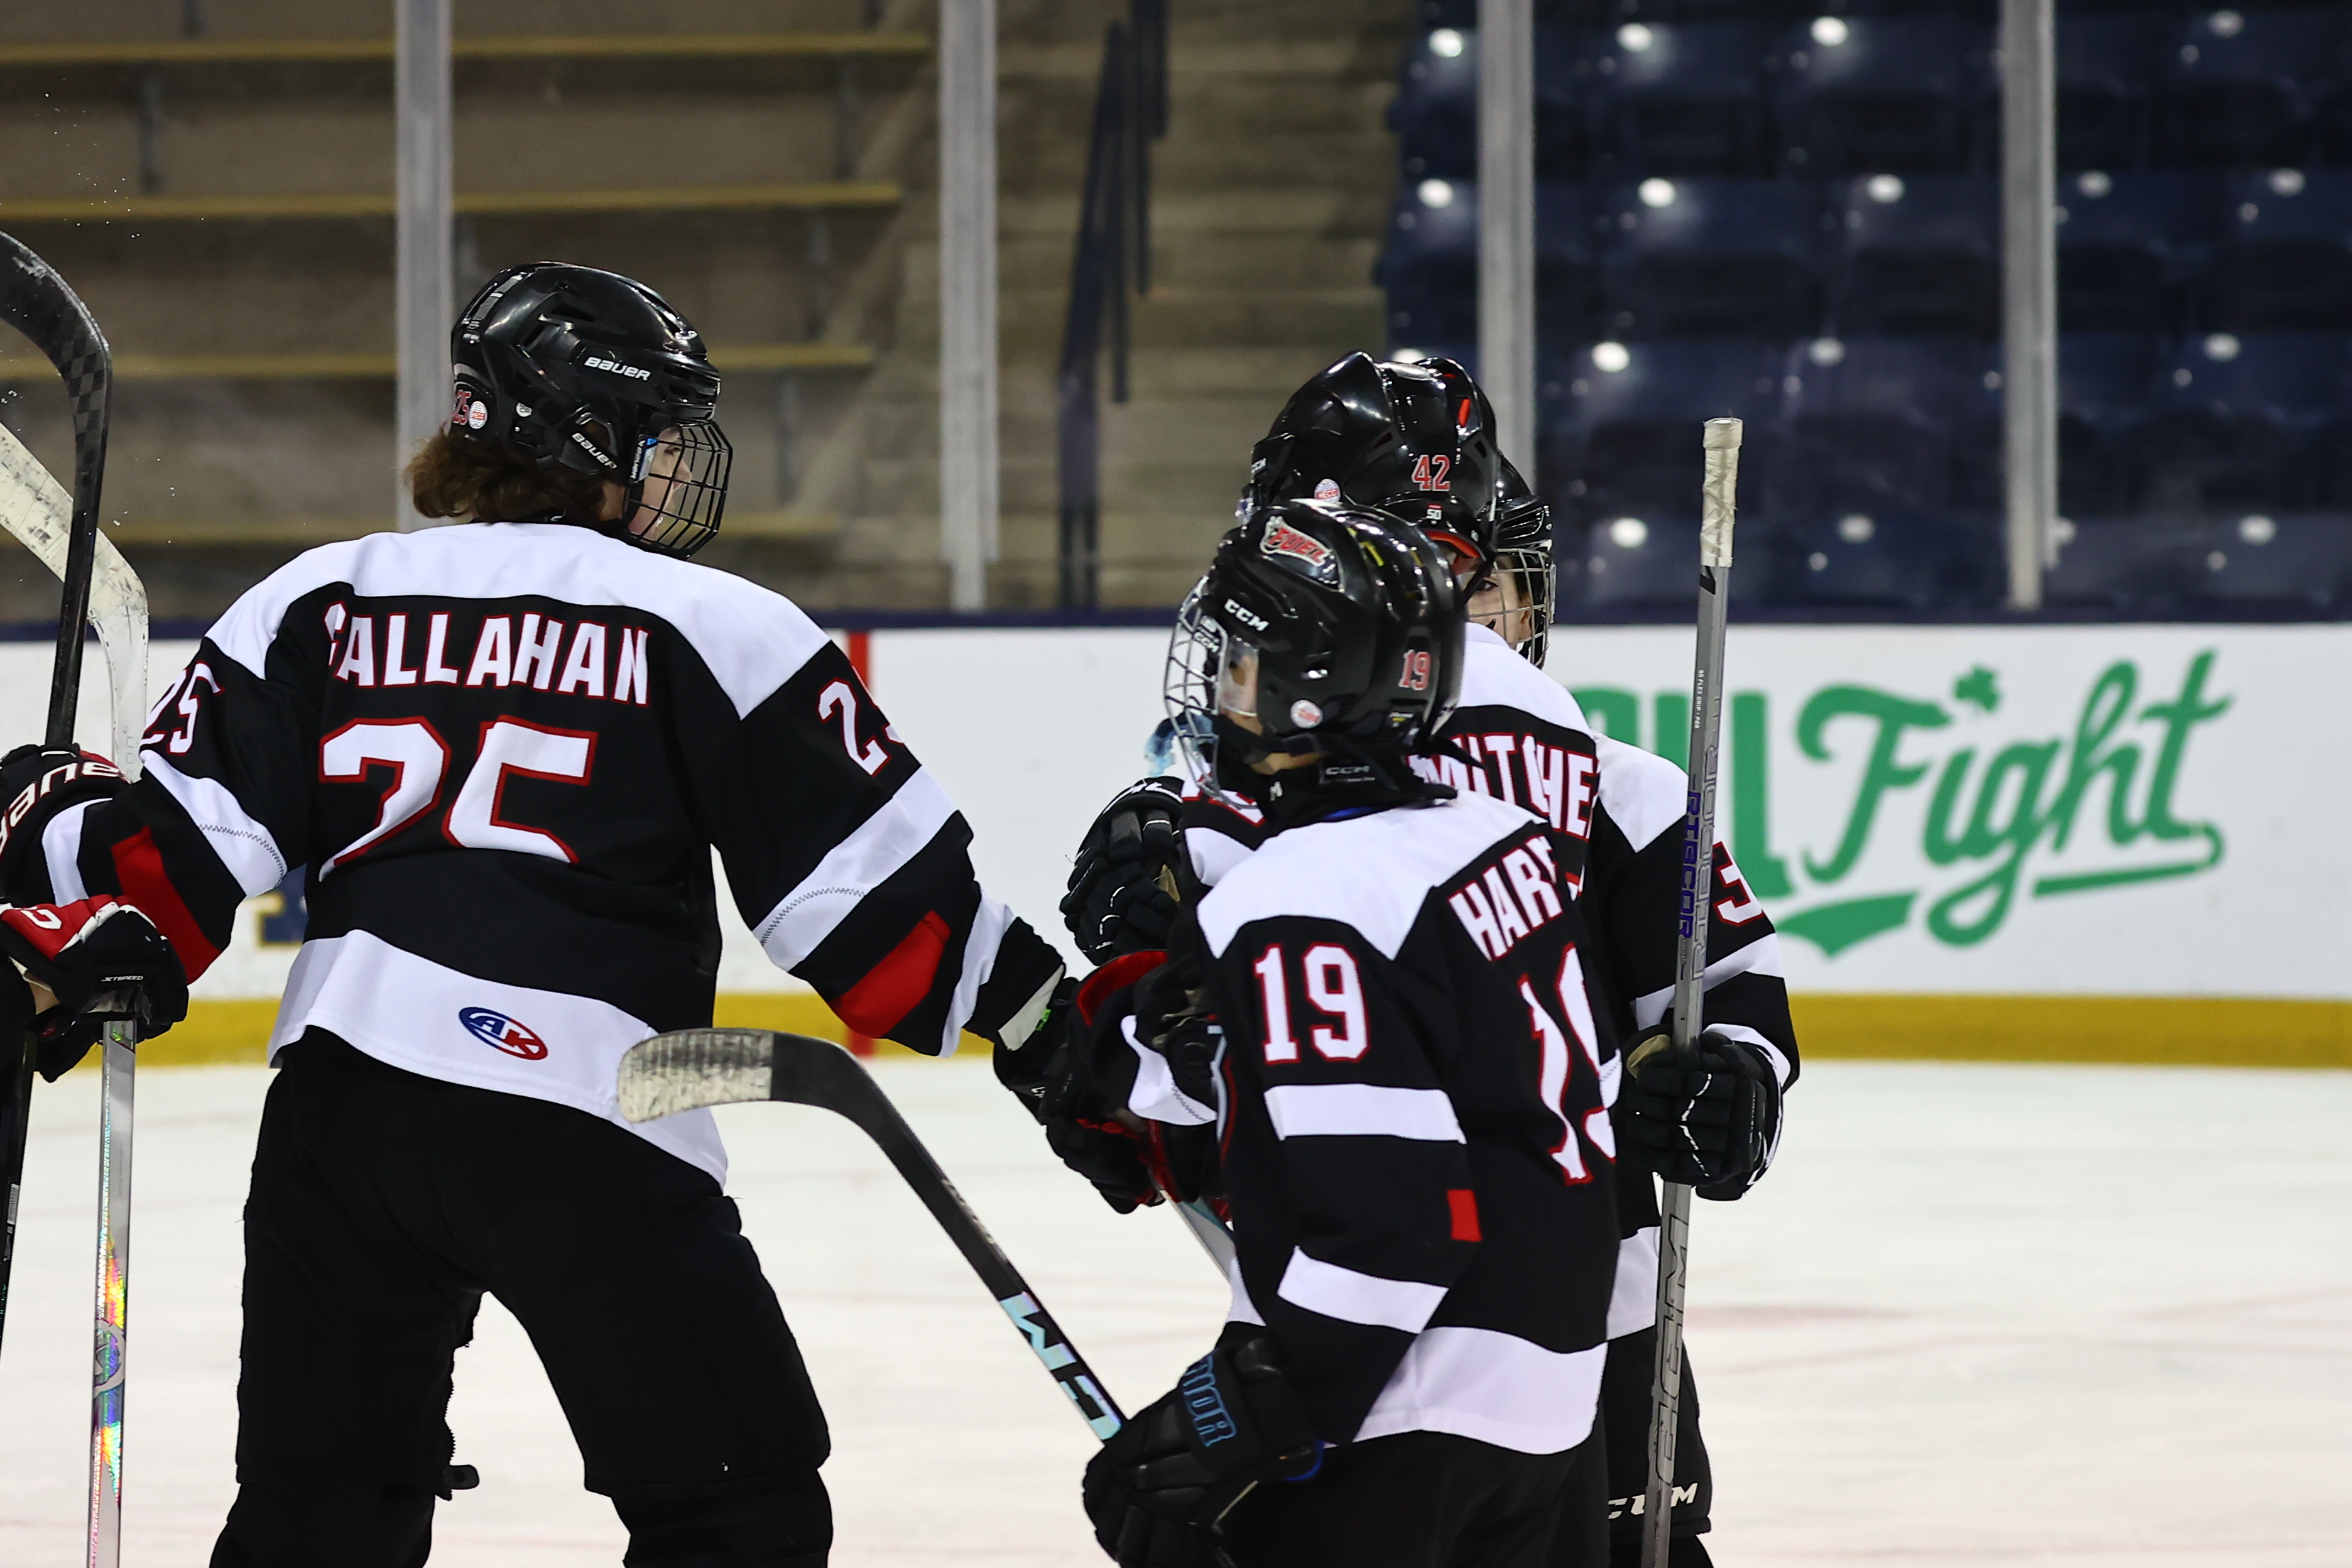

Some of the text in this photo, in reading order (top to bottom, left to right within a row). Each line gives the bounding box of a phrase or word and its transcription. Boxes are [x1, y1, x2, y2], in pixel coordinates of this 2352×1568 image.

[584, 356, 651, 381] BAUER
[571, 432, 618, 469] BAUER
[1411, 454, 1451, 491] 42
[1224, 598, 1270, 632] CCM
[1398, 649, 1432, 692] 19
[815, 666, 906, 778] 2
[318, 715, 597, 882] 25
[1797, 646, 2235, 947] Fight
[1679, 790, 1701, 939] RIBCOR
[101, 974, 144, 983] JETSPEED
[1255, 942, 1370, 1064] 19
[464, 1010, 547, 1059] AK
